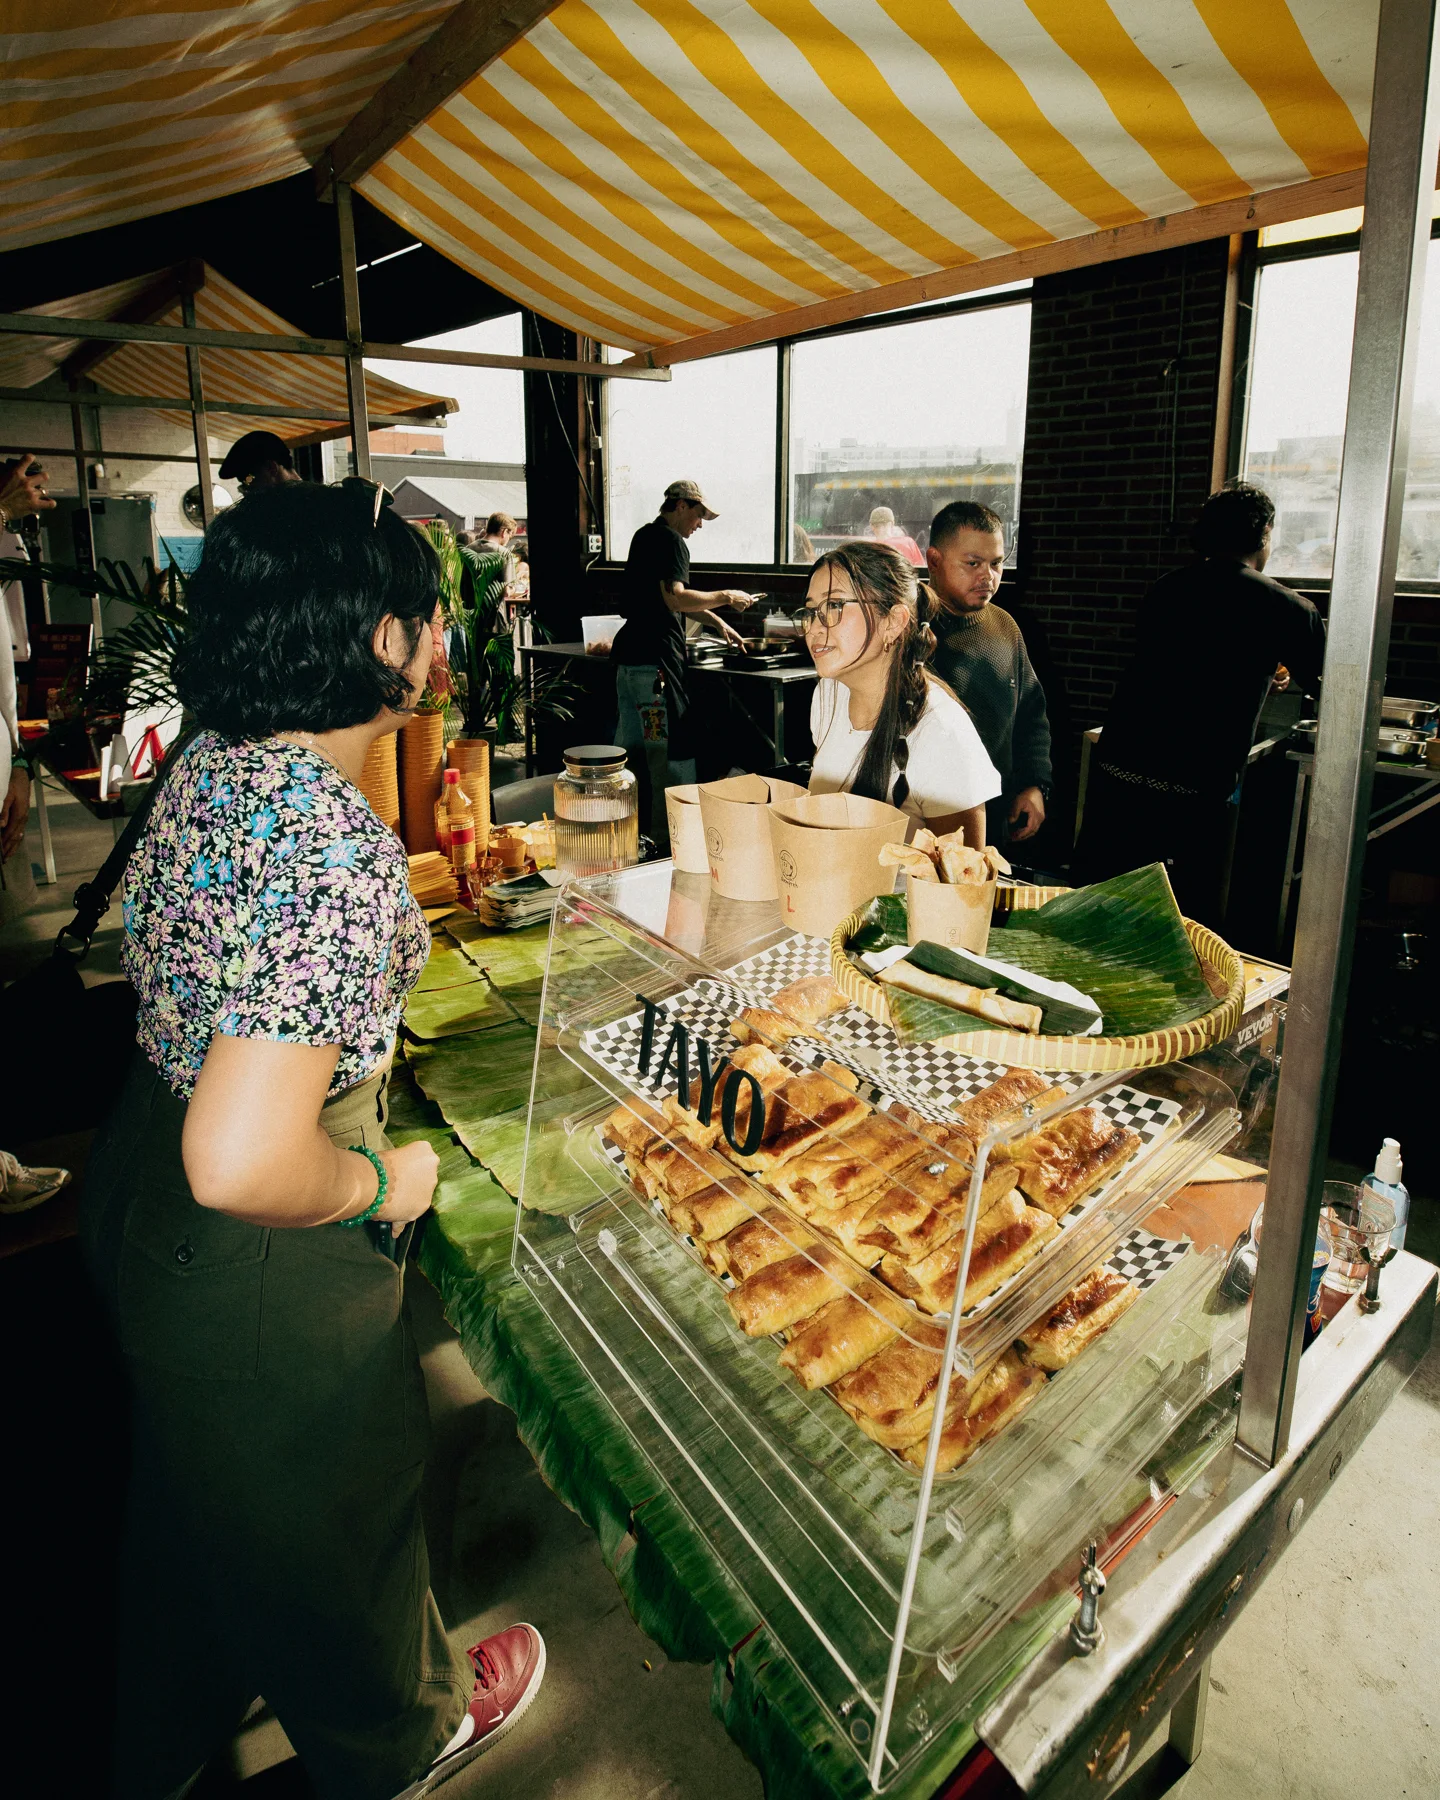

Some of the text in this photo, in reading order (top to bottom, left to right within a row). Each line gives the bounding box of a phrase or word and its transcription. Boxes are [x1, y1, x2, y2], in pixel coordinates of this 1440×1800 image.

[787, 895, 796, 912] L
[1237, 1012, 1274, 1045] VEVOR
[635, 993, 766, 1157] TAYO
